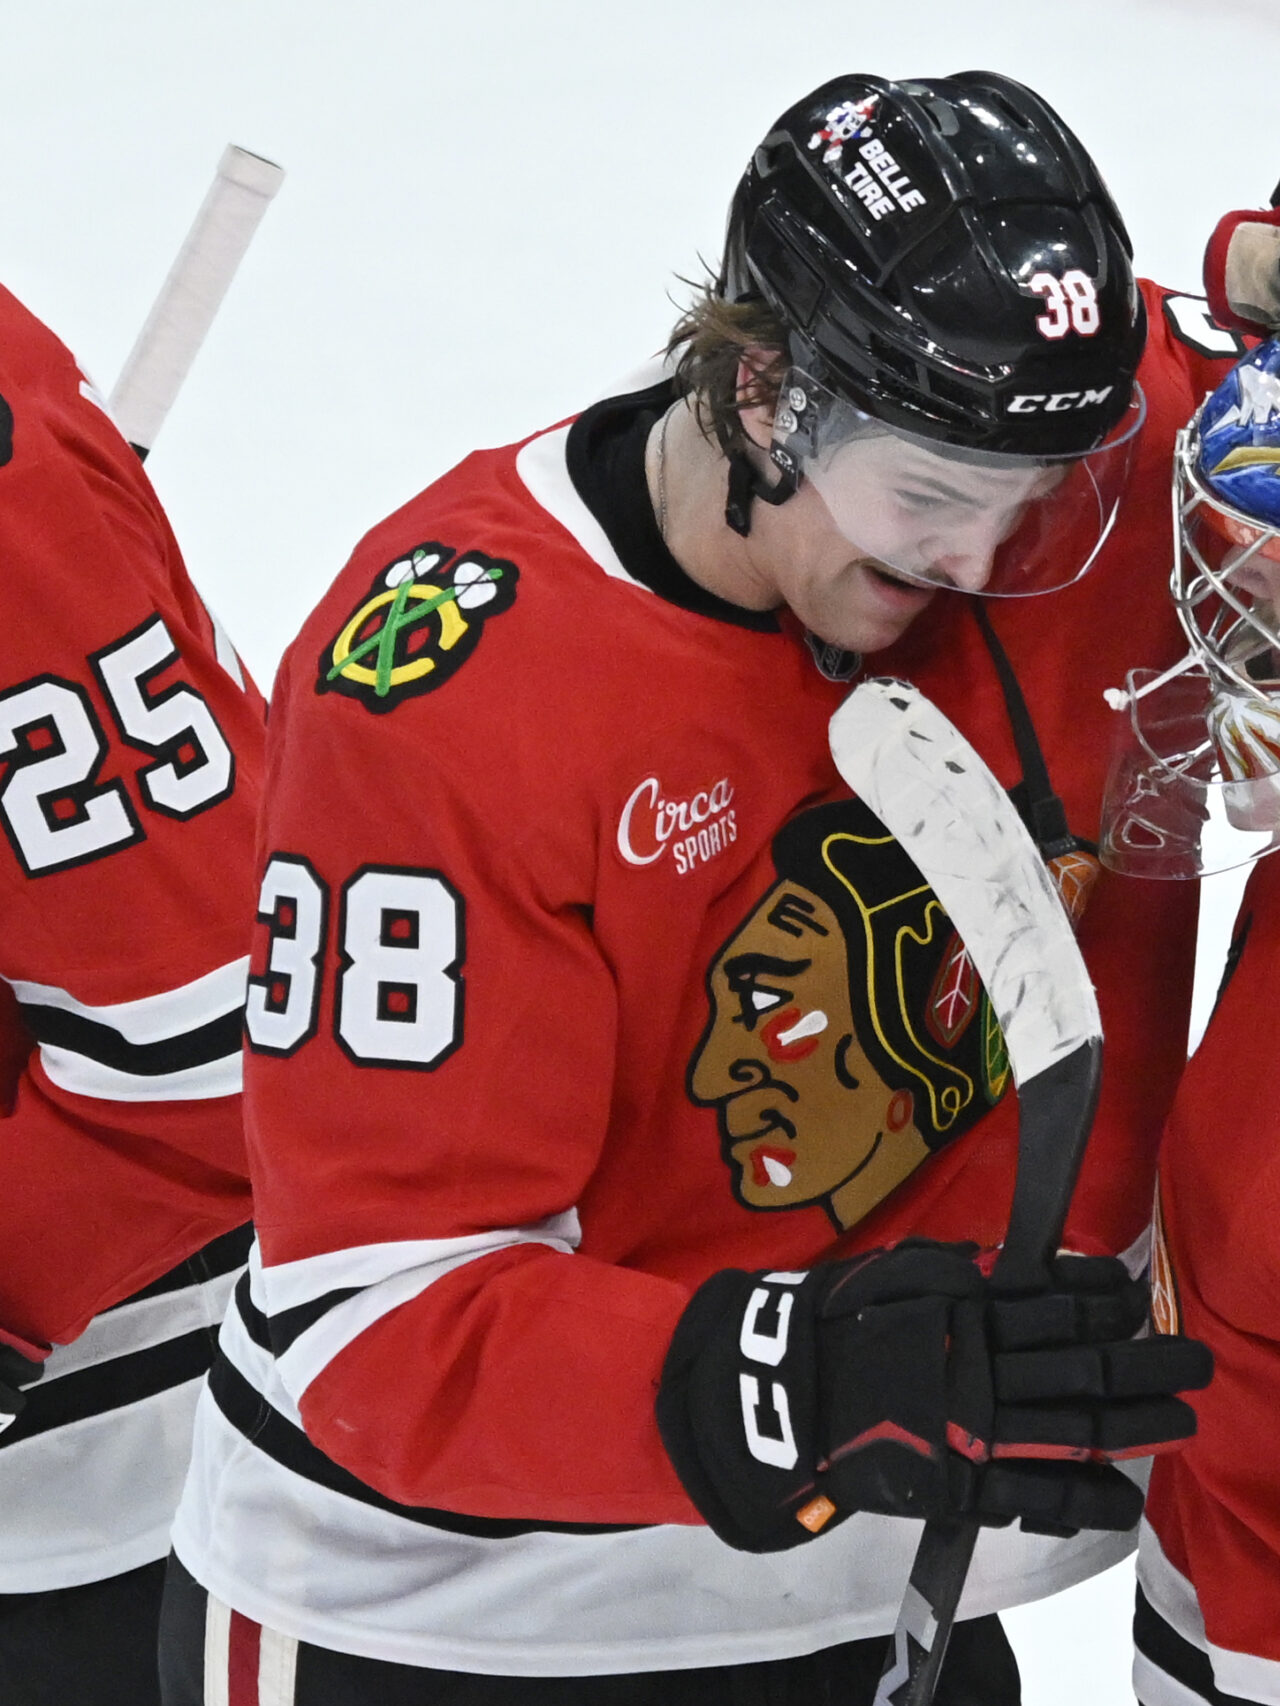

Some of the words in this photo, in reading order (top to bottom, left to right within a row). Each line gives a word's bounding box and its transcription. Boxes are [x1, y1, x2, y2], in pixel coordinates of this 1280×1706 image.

[844, 161, 896, 221] TIRE
[859, 138, 927, 213] BELLE
[1030, 270, 1101, 341] 38
[1007, 386, 1114, 413] CCM
[0, 612, 236, 878] 25
[617, 777, 734, 866] Circa
[673, 809, 738, 875] SPORTS
[243, 851, 466, 1071] 38
[739, 1270, 811, 1470] CC
